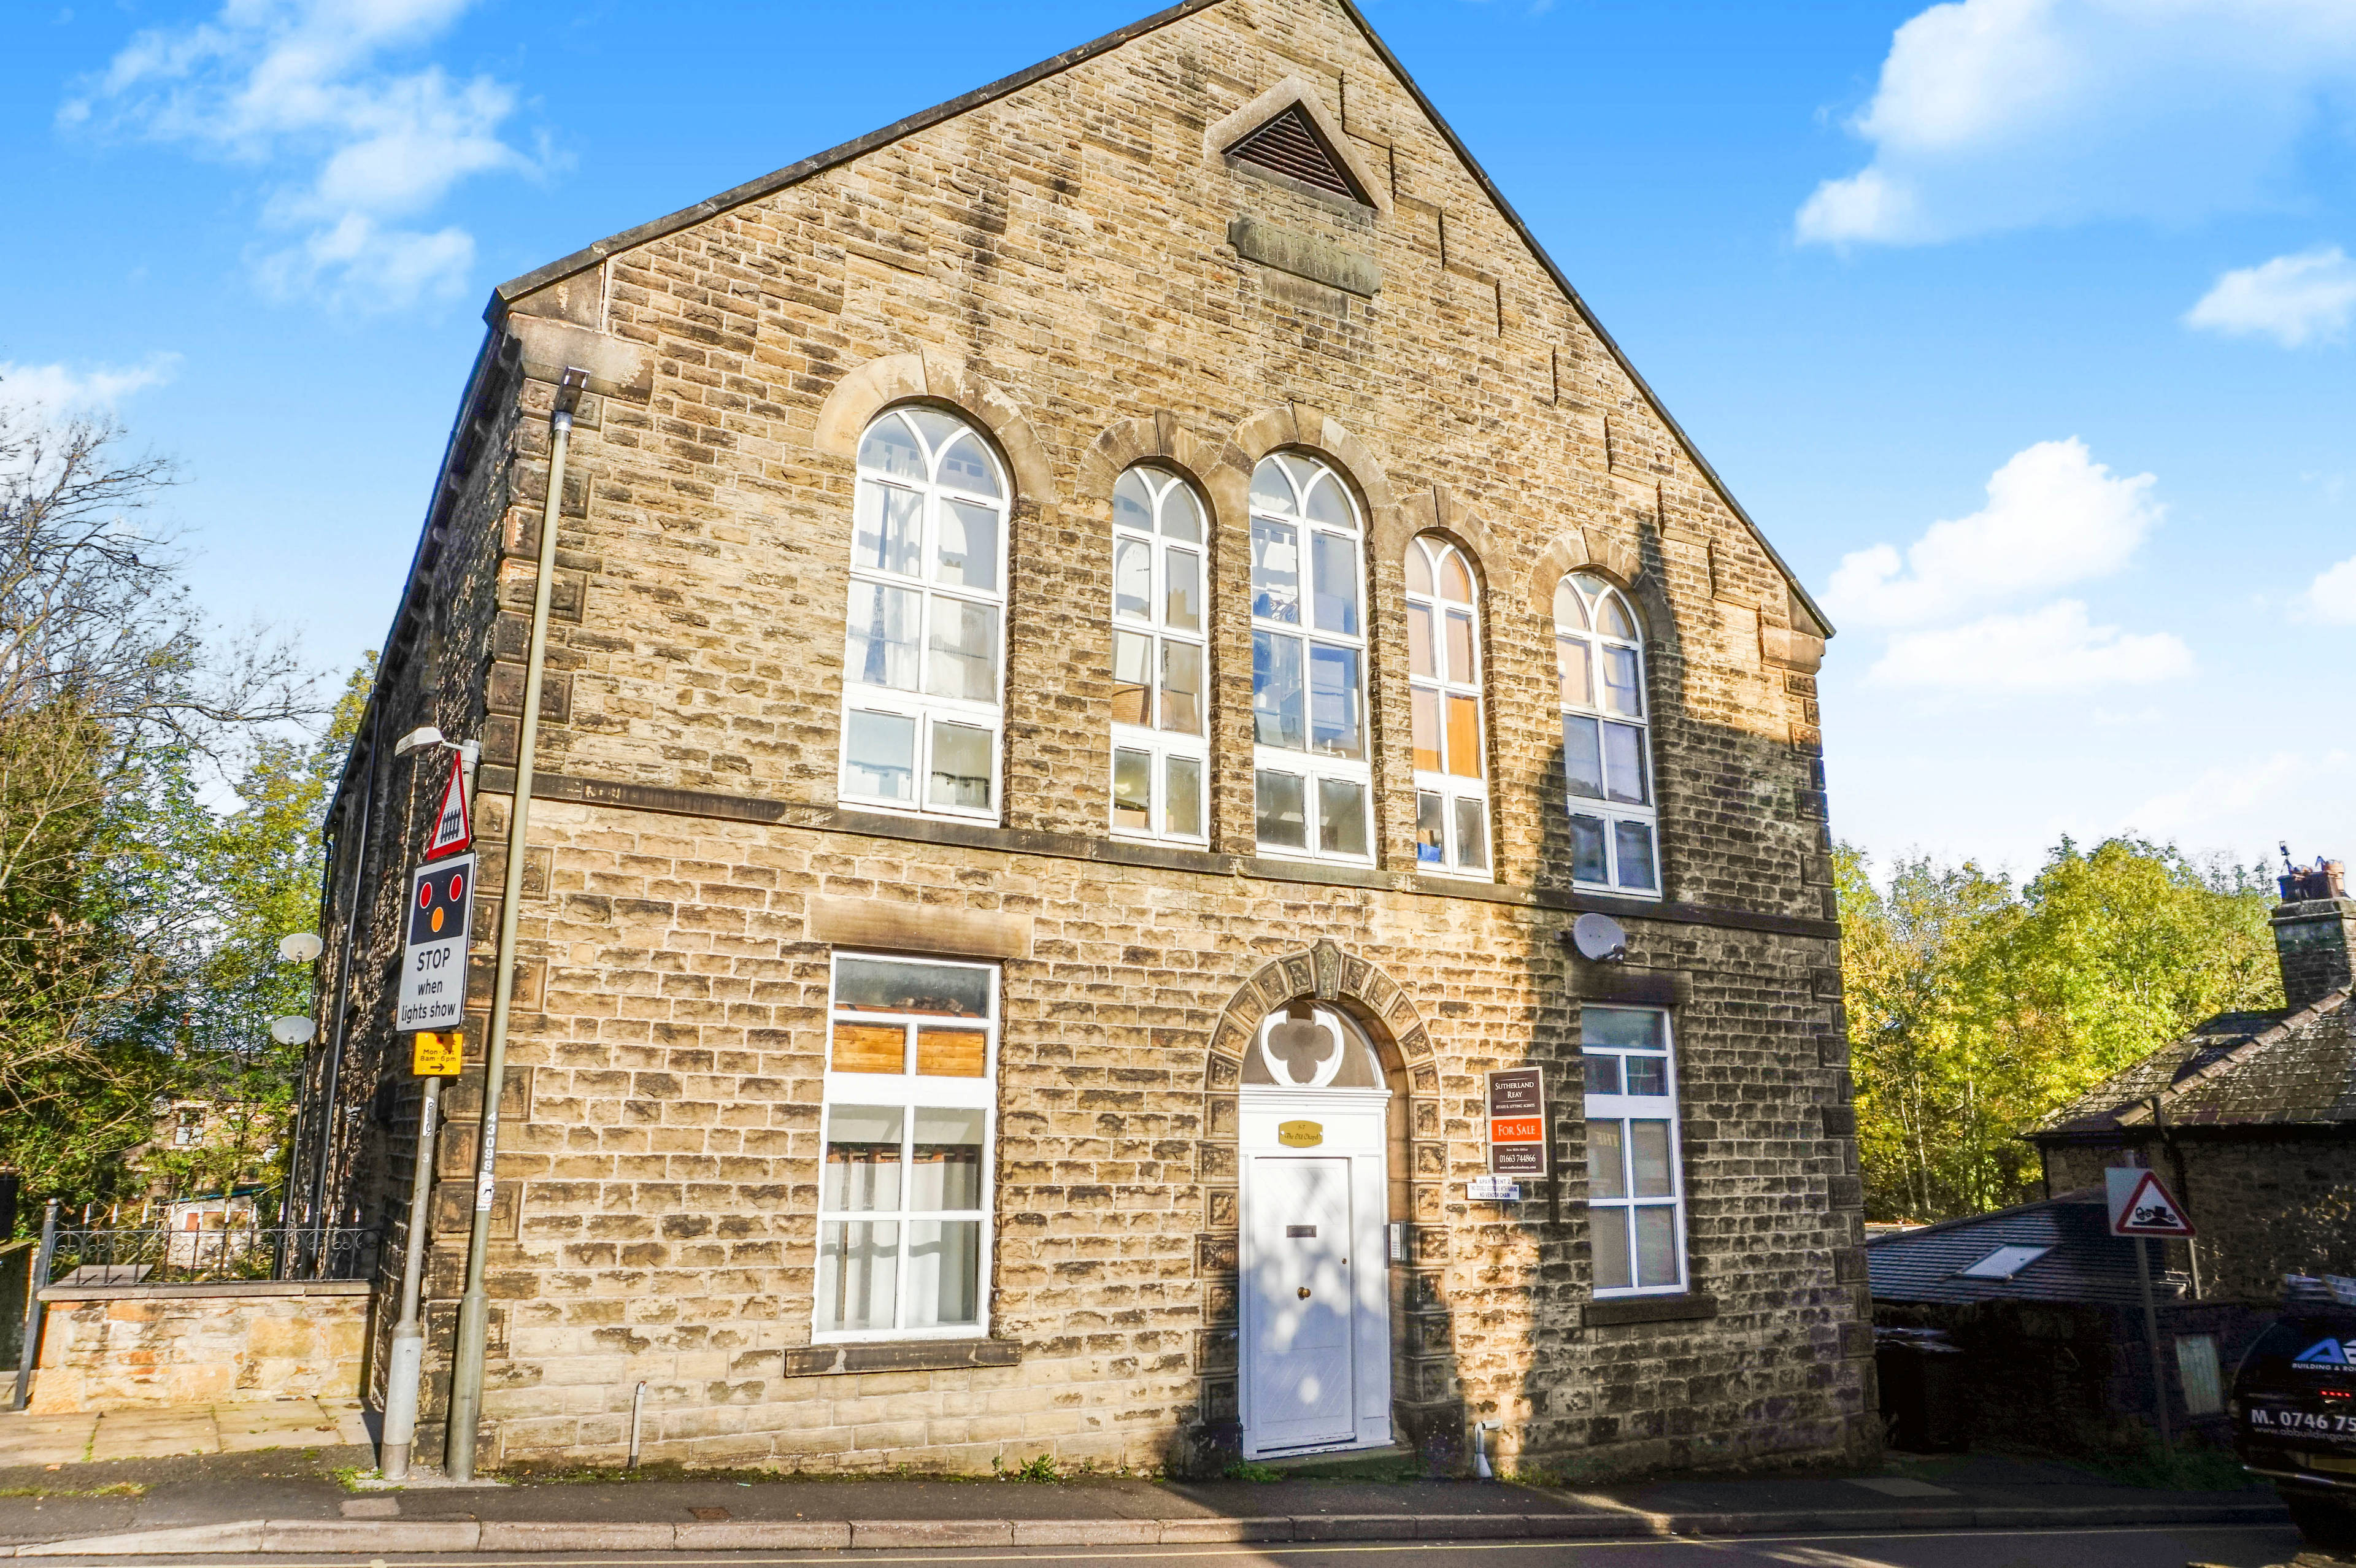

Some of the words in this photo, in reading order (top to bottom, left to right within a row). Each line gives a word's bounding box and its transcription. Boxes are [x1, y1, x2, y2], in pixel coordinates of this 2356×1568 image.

[1249, 222, 1351, 266] METHODIST
[1243, 239, 1288, 264] FREE
[1295, 255, 1363, 290] CHURCH
[417, 947, 450, 972] STOP
[418, 978, 443, 996] when
[401, 1003, 428, 1024] lights
[430, 1001, 456, 1018] show
[483, 1111, 497, 1171] 43098
[1516, 1154, 1536, 1163] 744866
[2280, 1412, 2329, 1429] 0746
